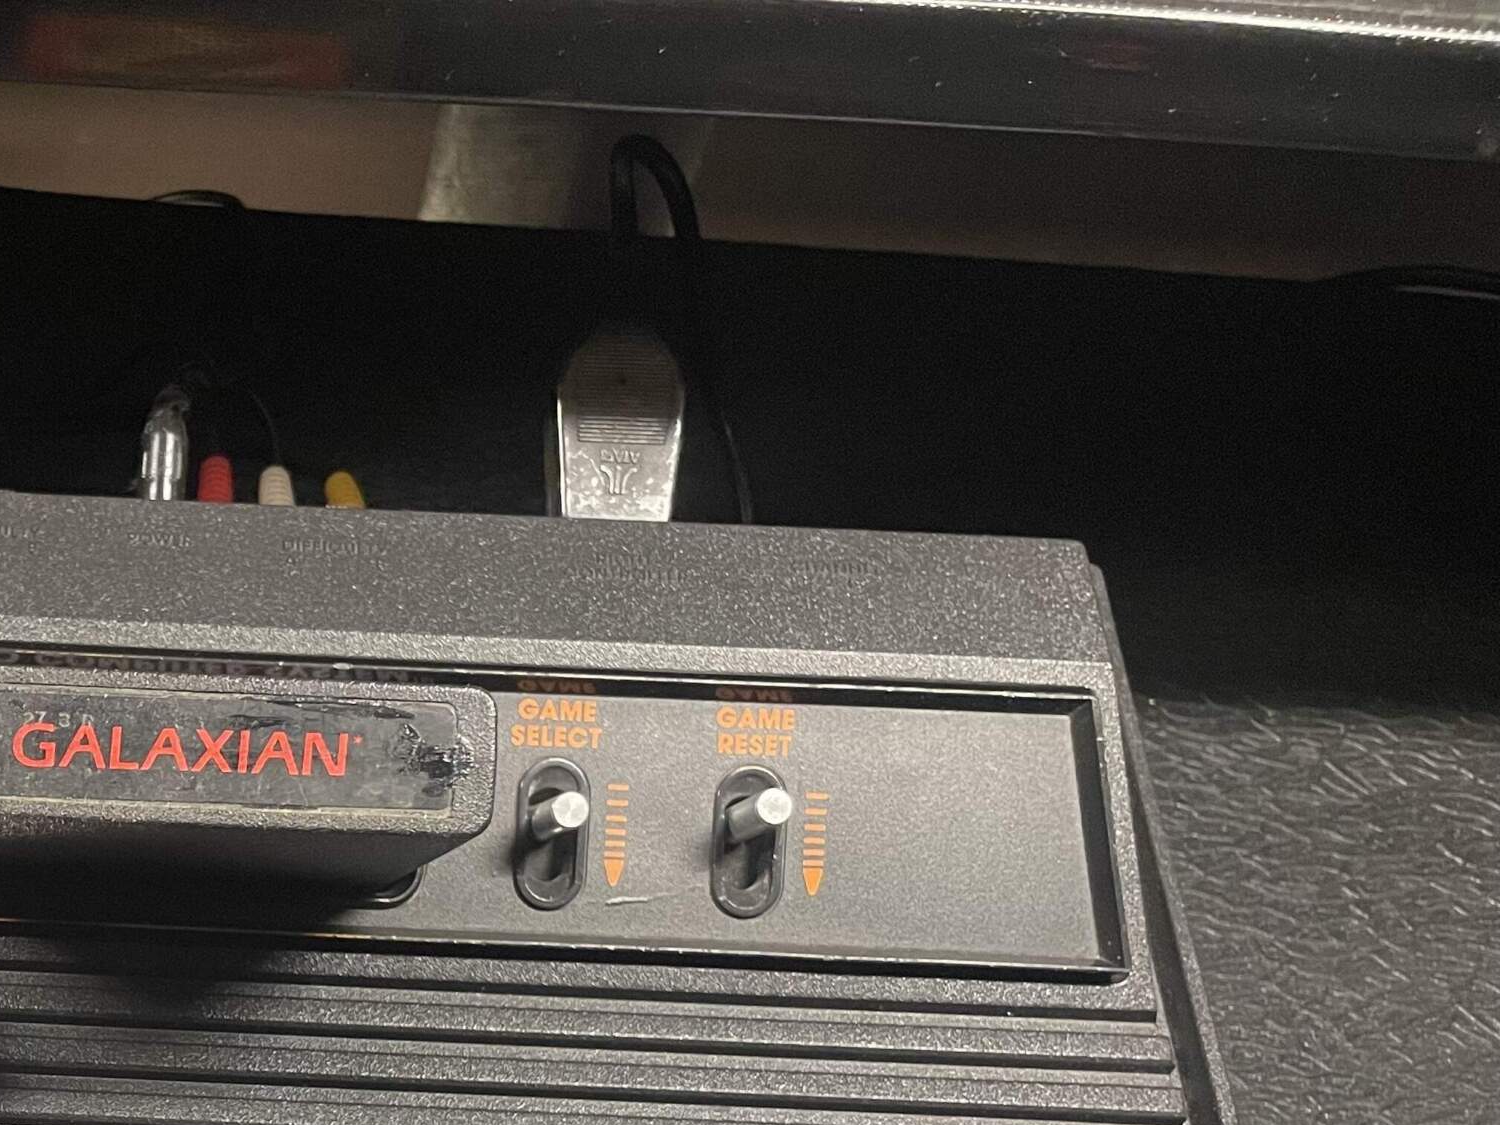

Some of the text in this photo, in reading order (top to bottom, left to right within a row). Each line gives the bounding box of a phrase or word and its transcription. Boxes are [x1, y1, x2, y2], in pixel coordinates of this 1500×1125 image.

[517, 698, 597, 722] GAME
[716, 705, 796, 731] GAME
[510, 723, 603, 749] SELECT
[717, 733, 792, 757] RESET
